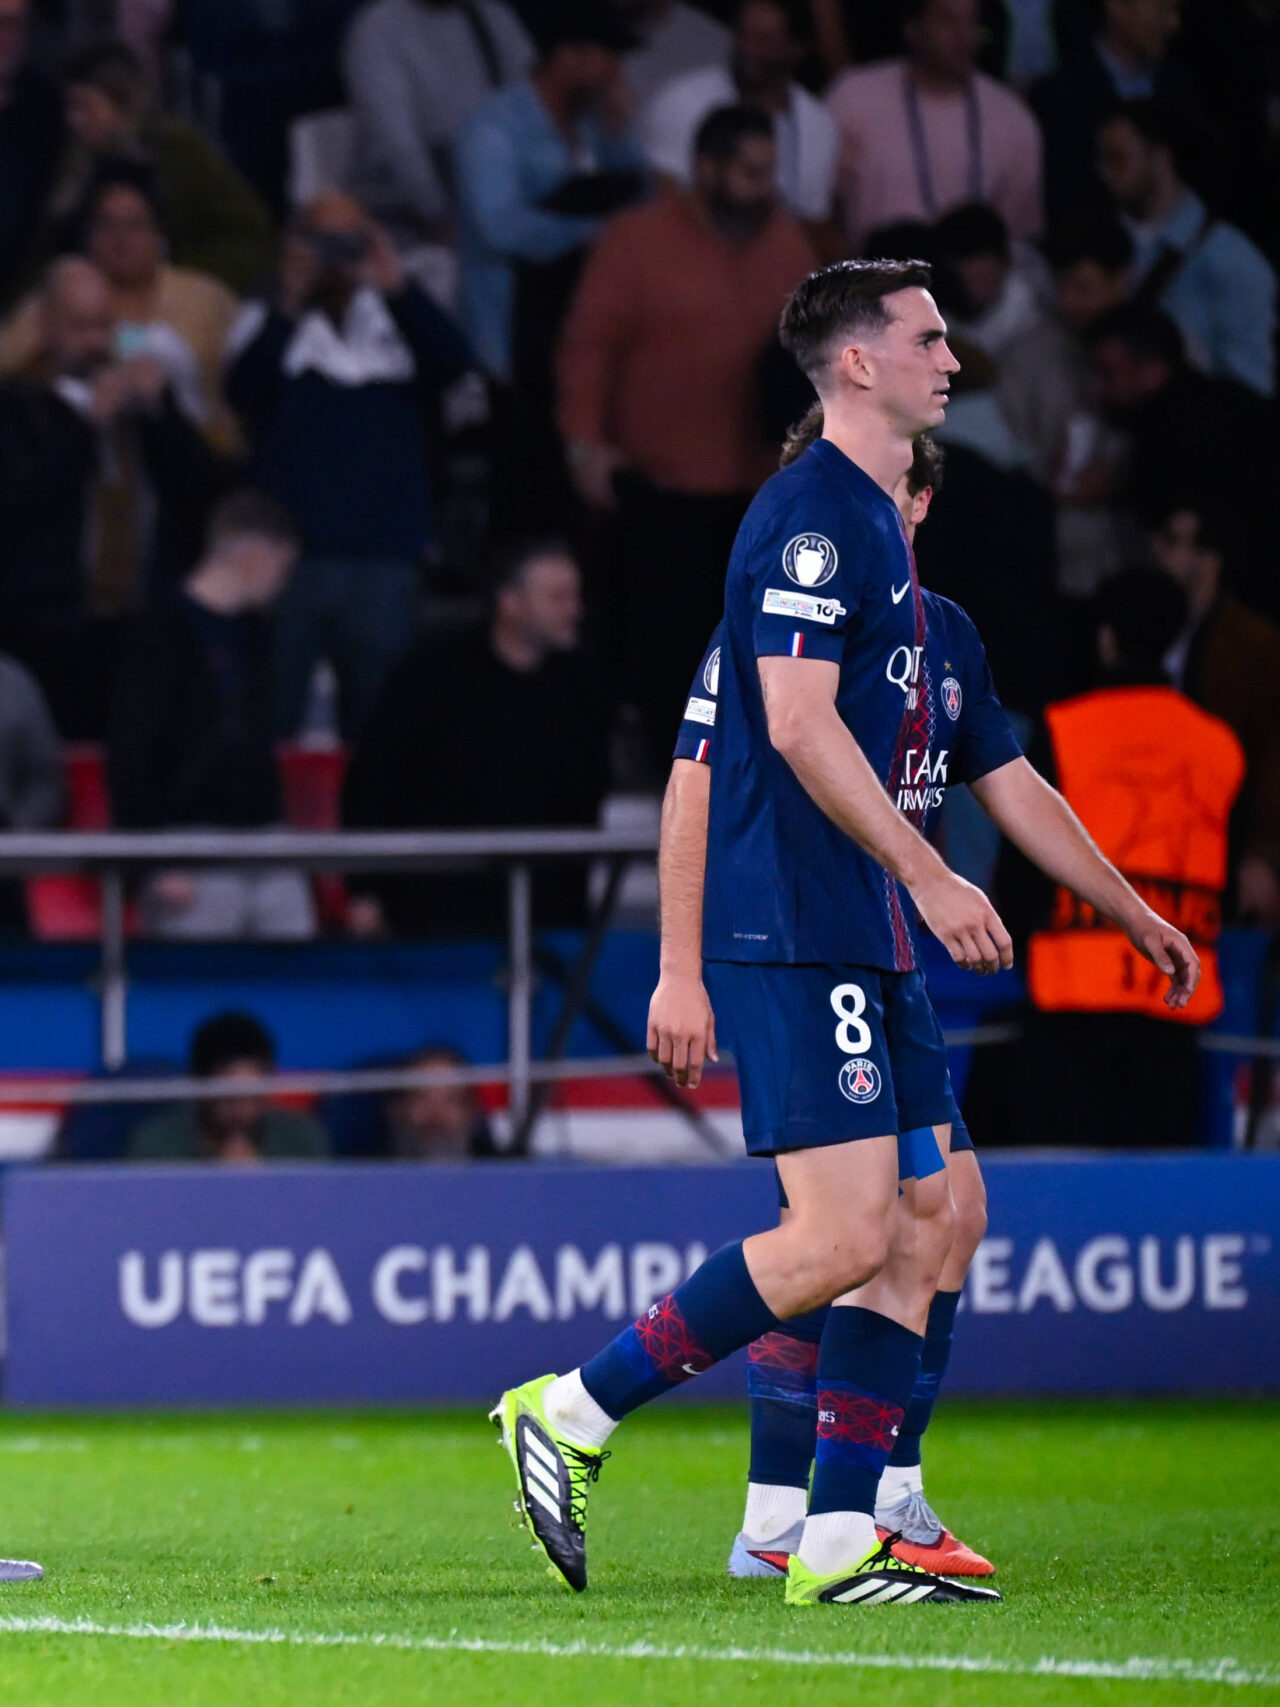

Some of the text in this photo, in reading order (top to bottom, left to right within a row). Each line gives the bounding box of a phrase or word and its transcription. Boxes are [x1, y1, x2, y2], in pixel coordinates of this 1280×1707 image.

[830, 983, 872, 1055] 8
[844, 1060, 872, 1073] PARIS
[121, 1248, 353, 1328] UEFA
[959, 1235, 1248, 1314] EAGUE
